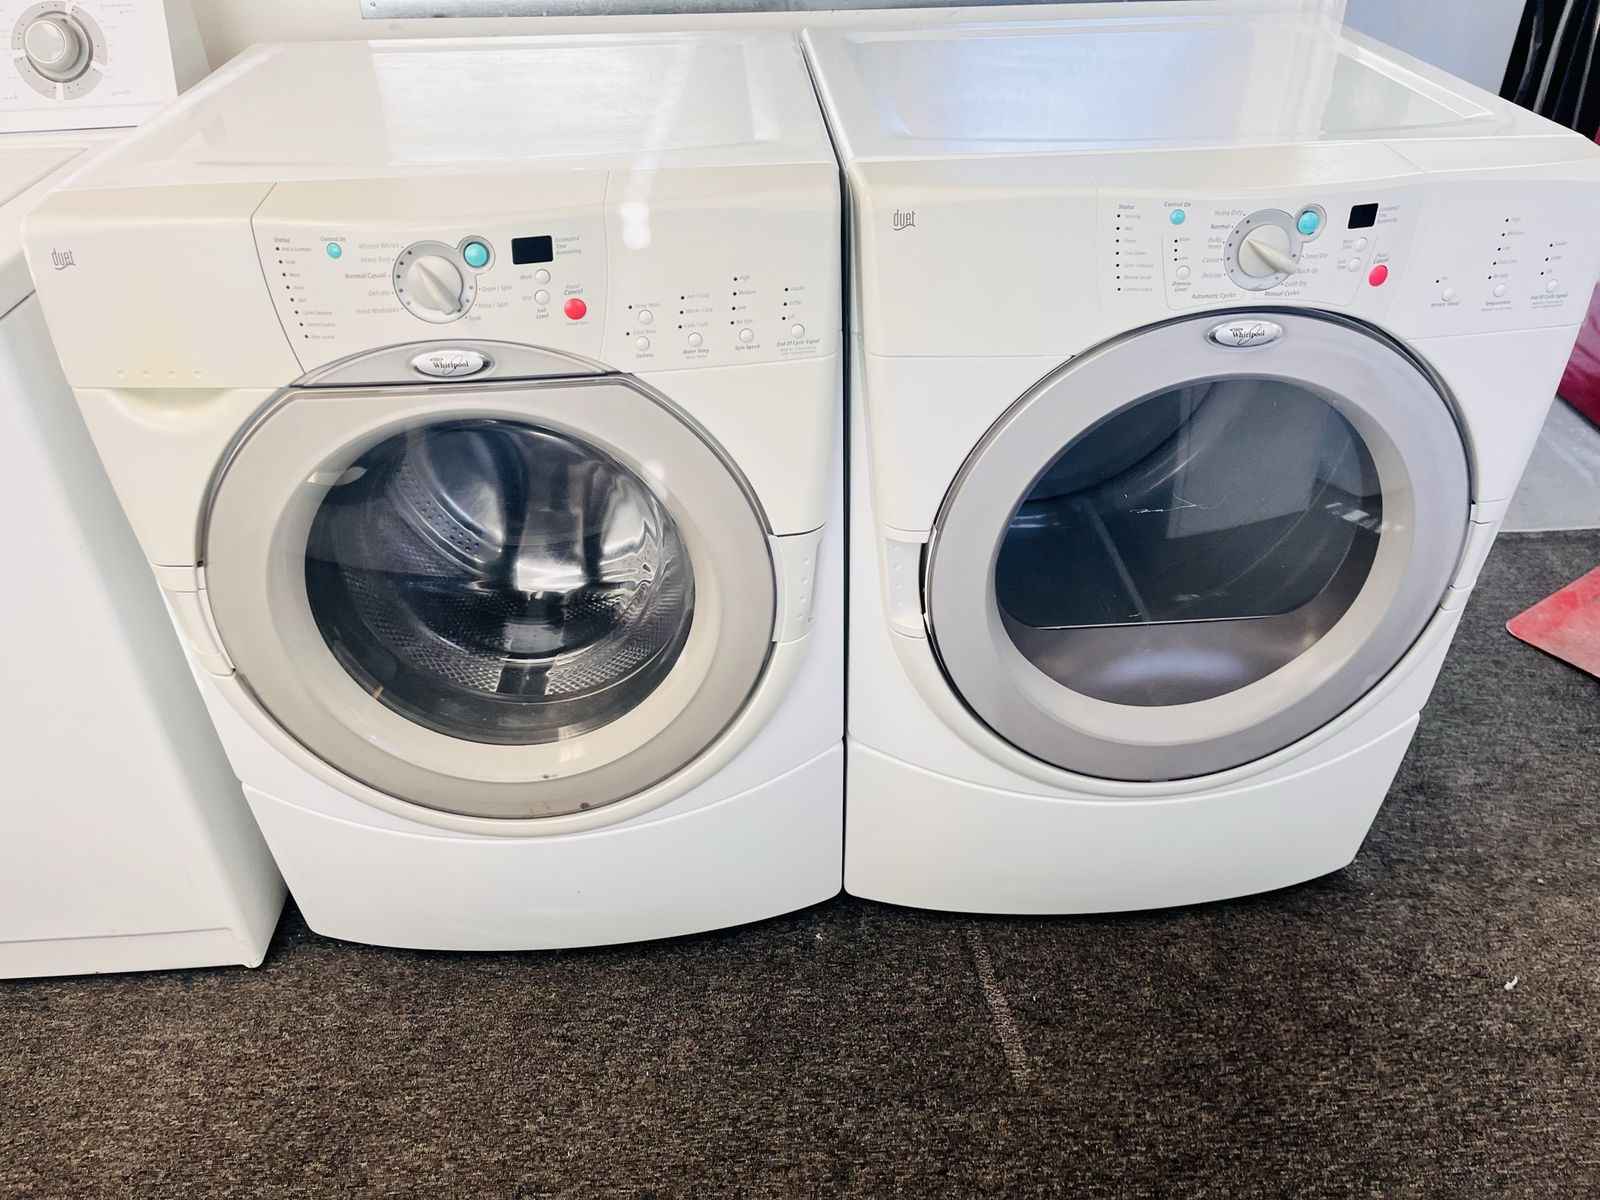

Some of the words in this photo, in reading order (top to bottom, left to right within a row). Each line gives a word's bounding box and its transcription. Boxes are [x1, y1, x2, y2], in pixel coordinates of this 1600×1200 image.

[893, 209, 916, 231] duet
[51, 248, 76, 270] duet
[1232, 330, 1265, 340] Whirlpool
[432, 360, 470, 370] Whirlpool
